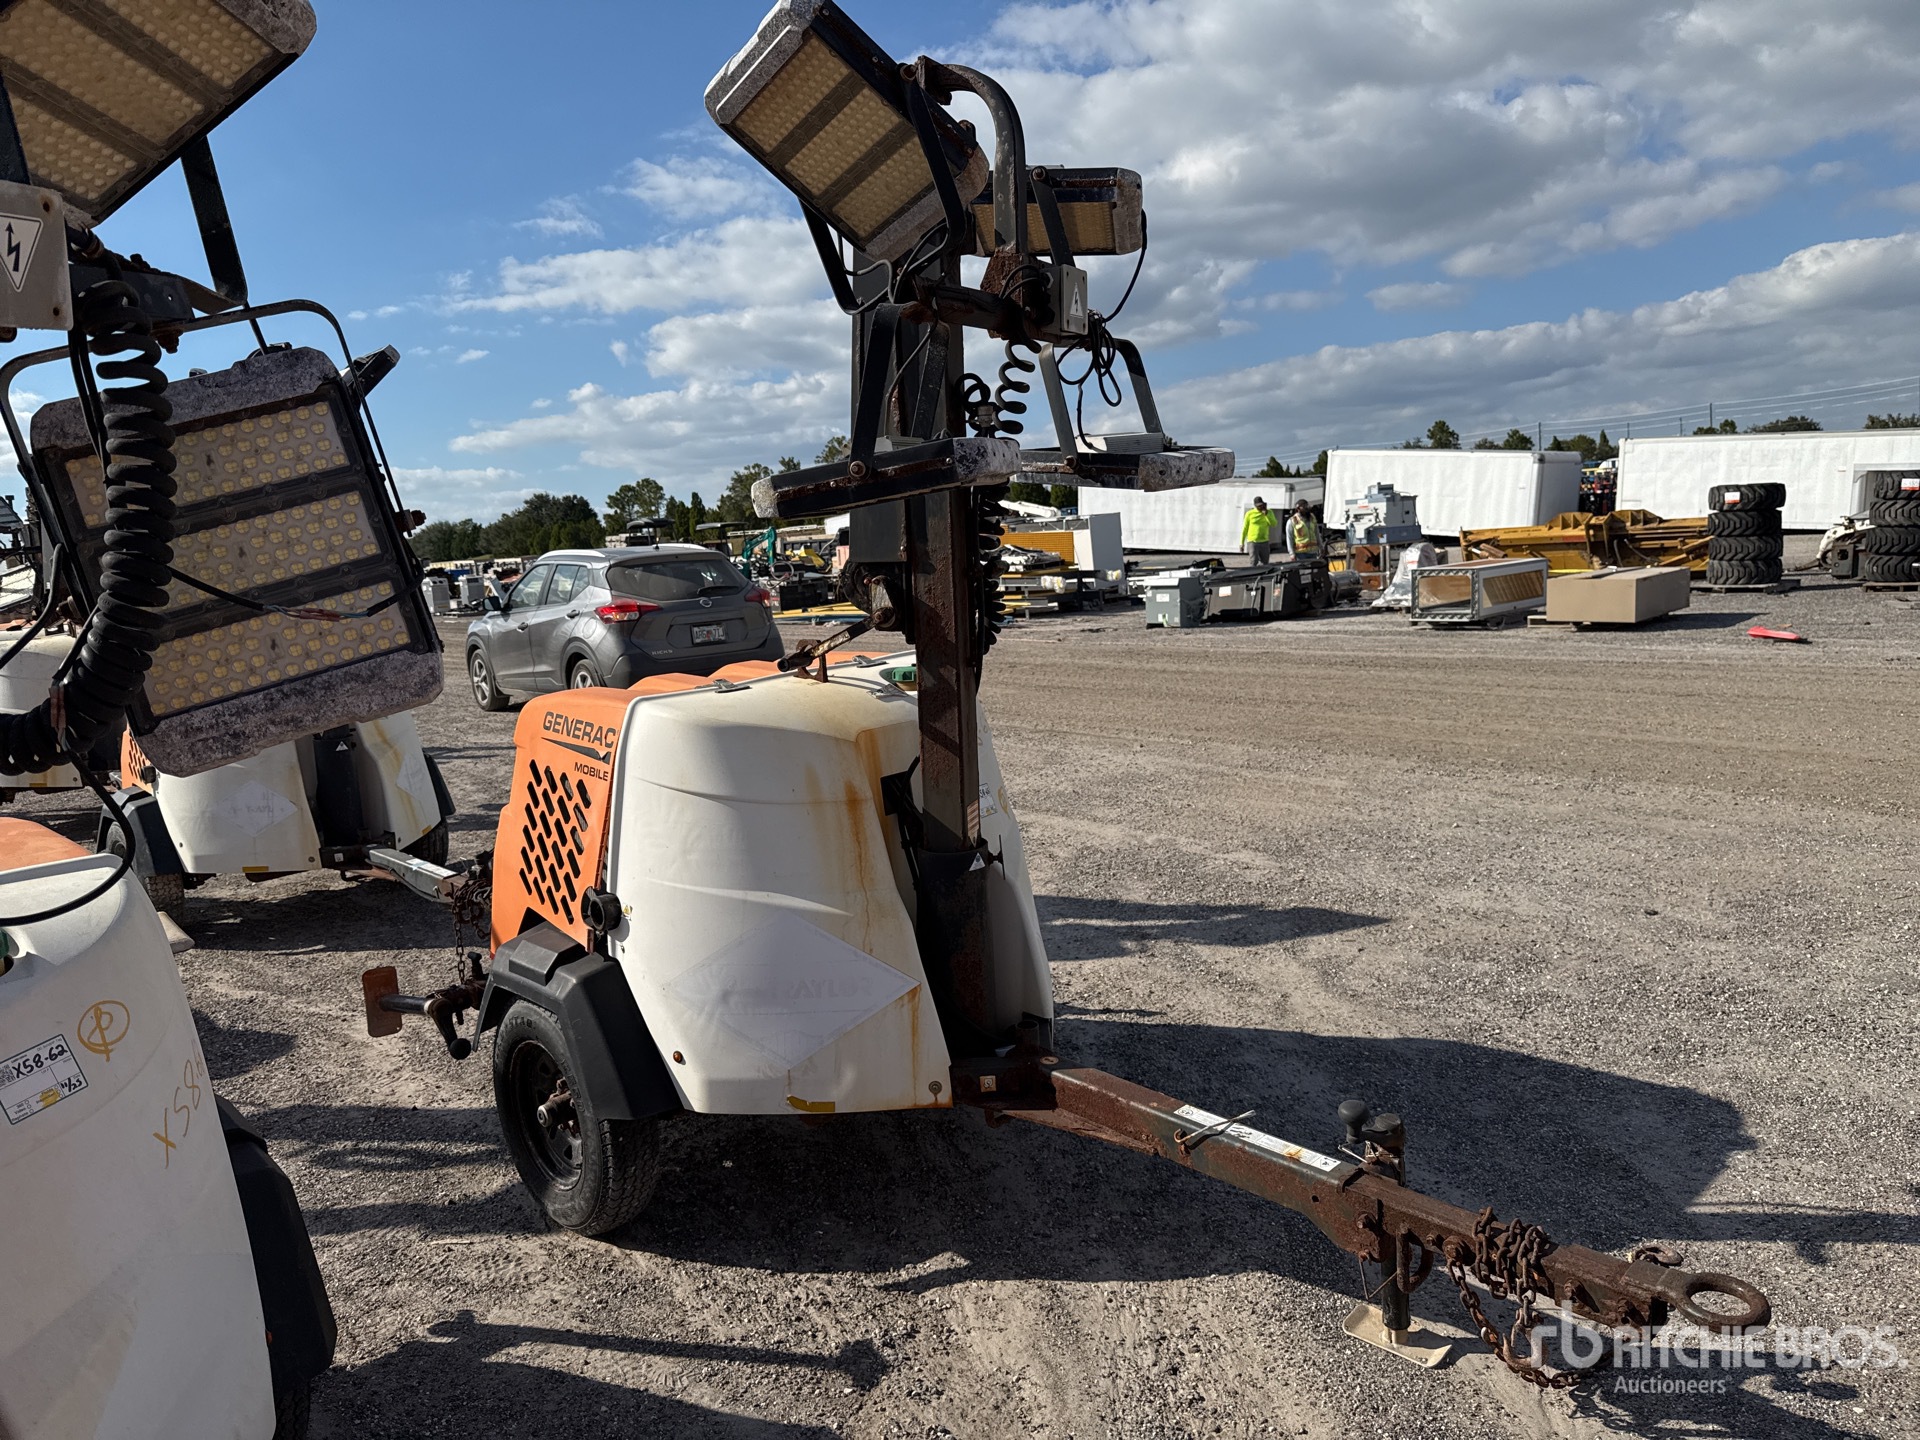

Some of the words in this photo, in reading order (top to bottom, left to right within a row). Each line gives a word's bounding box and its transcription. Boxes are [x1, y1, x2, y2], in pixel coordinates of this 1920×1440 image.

[543, 711, 616, 749] GENERAC
[574, 762, 609, 781] MOBILE
[12, 1044, 68, 1079] X58-62
